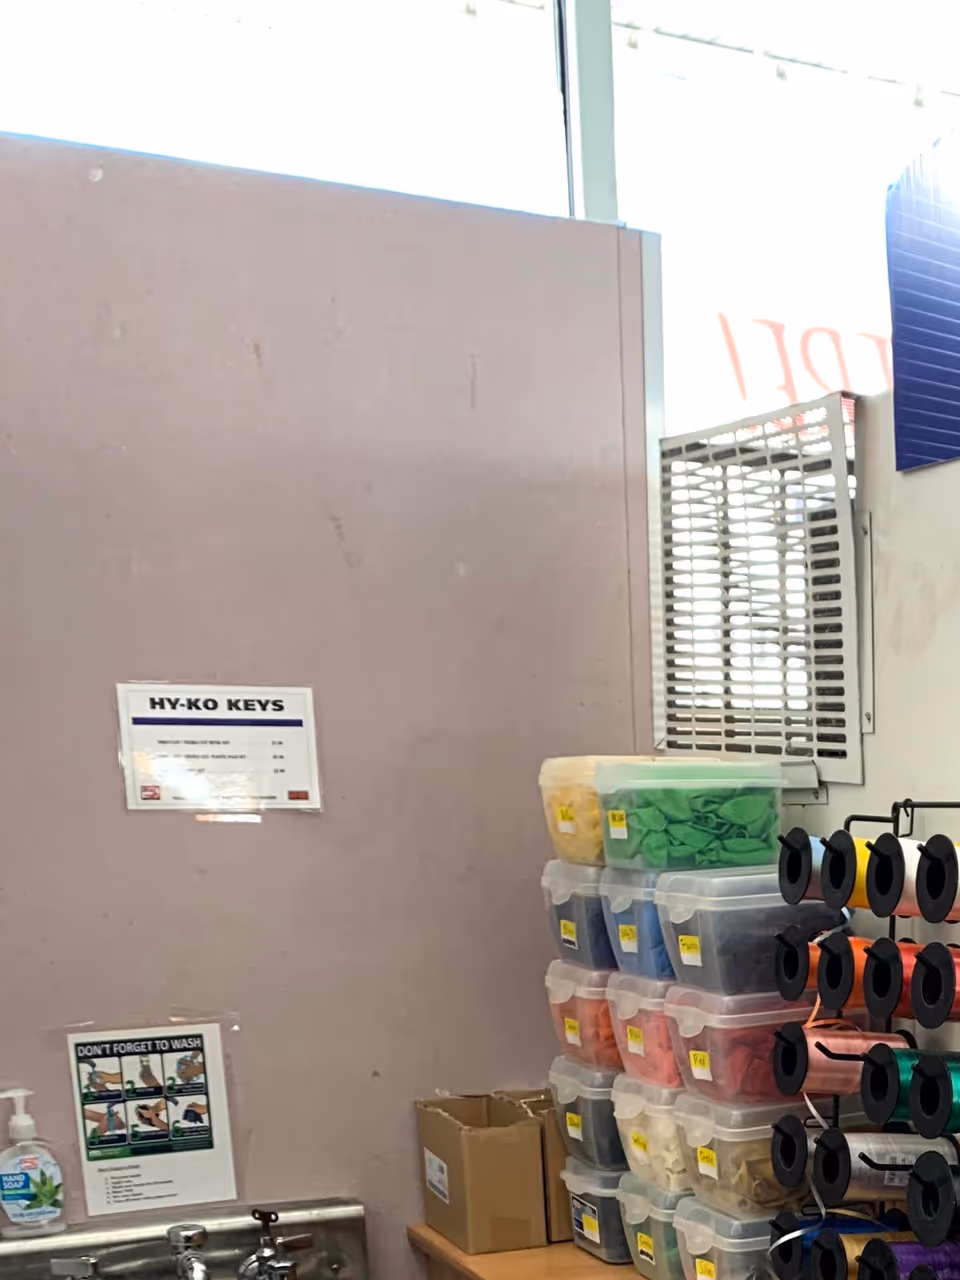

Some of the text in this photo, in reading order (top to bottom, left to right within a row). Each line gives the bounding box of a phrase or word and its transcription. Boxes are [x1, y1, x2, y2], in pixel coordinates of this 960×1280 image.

[149, 697, 285, 711] HY-KO KEYS
[77, 1038, 201, 1056] DON'T FORGET TO WASH
